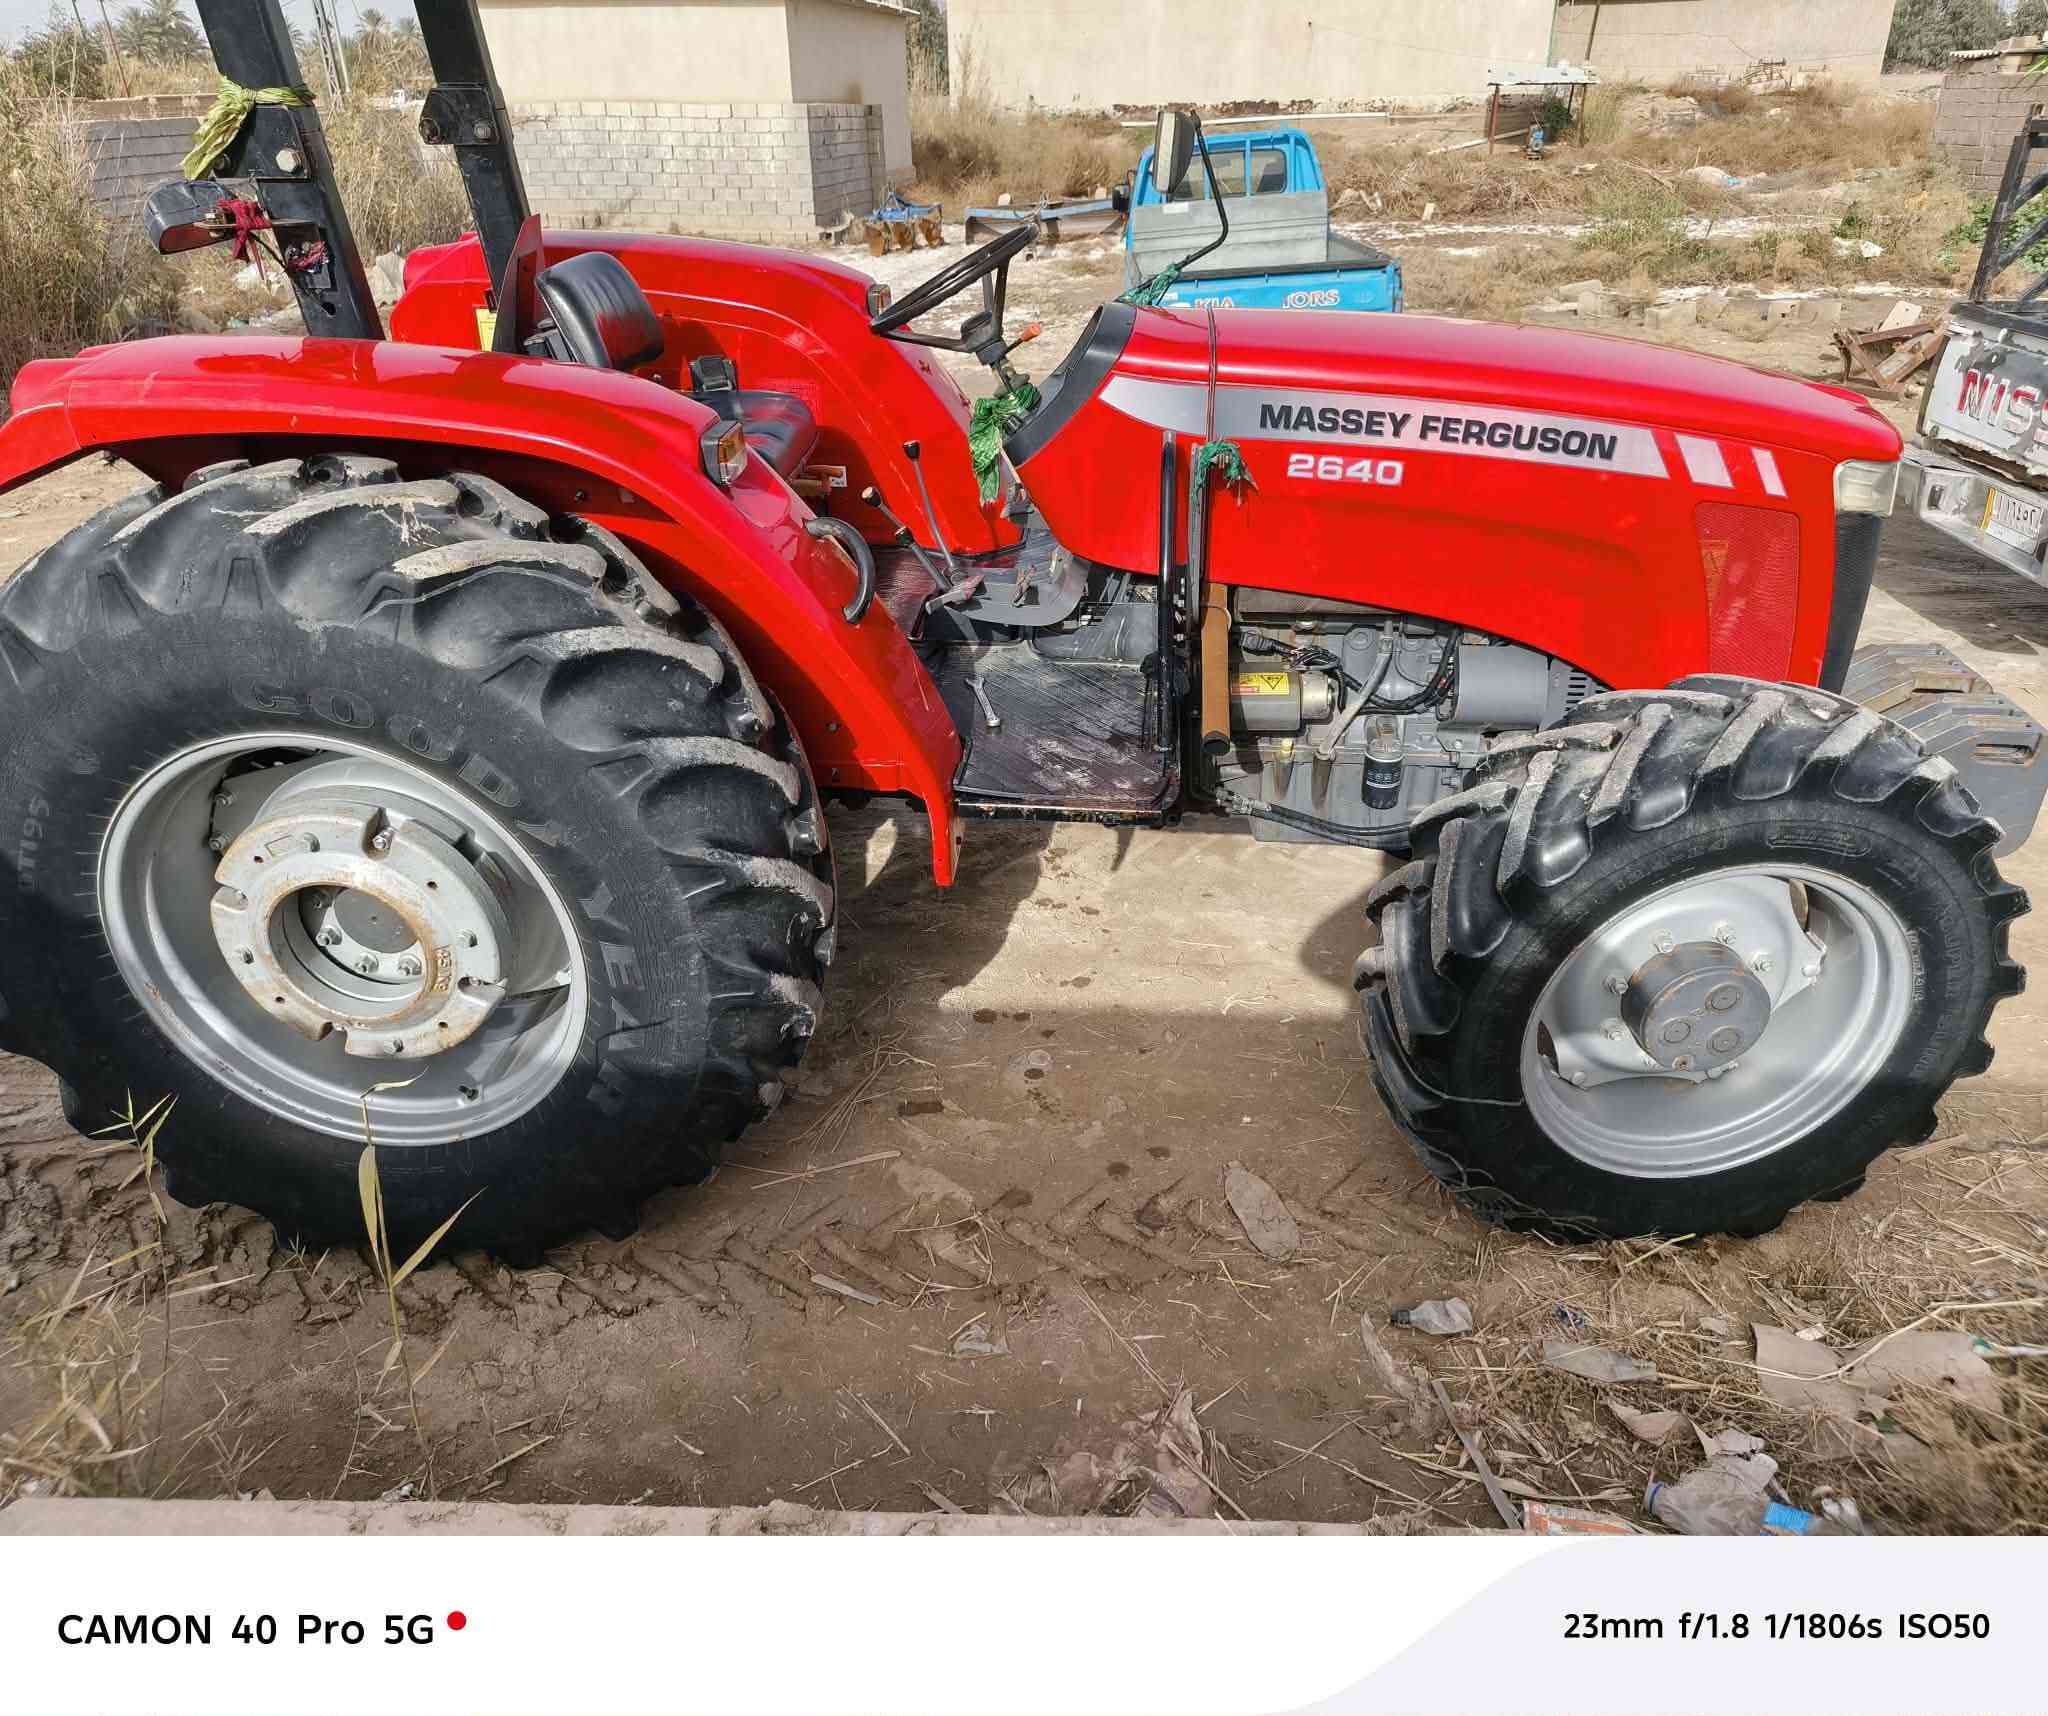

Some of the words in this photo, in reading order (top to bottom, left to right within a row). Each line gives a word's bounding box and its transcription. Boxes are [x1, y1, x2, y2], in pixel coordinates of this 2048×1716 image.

[1259, 403, 1411, 440] MASSEY
[1418, 415, 1619, 461] FERGUSON
[1287, 453, 1405, 486] 2640
